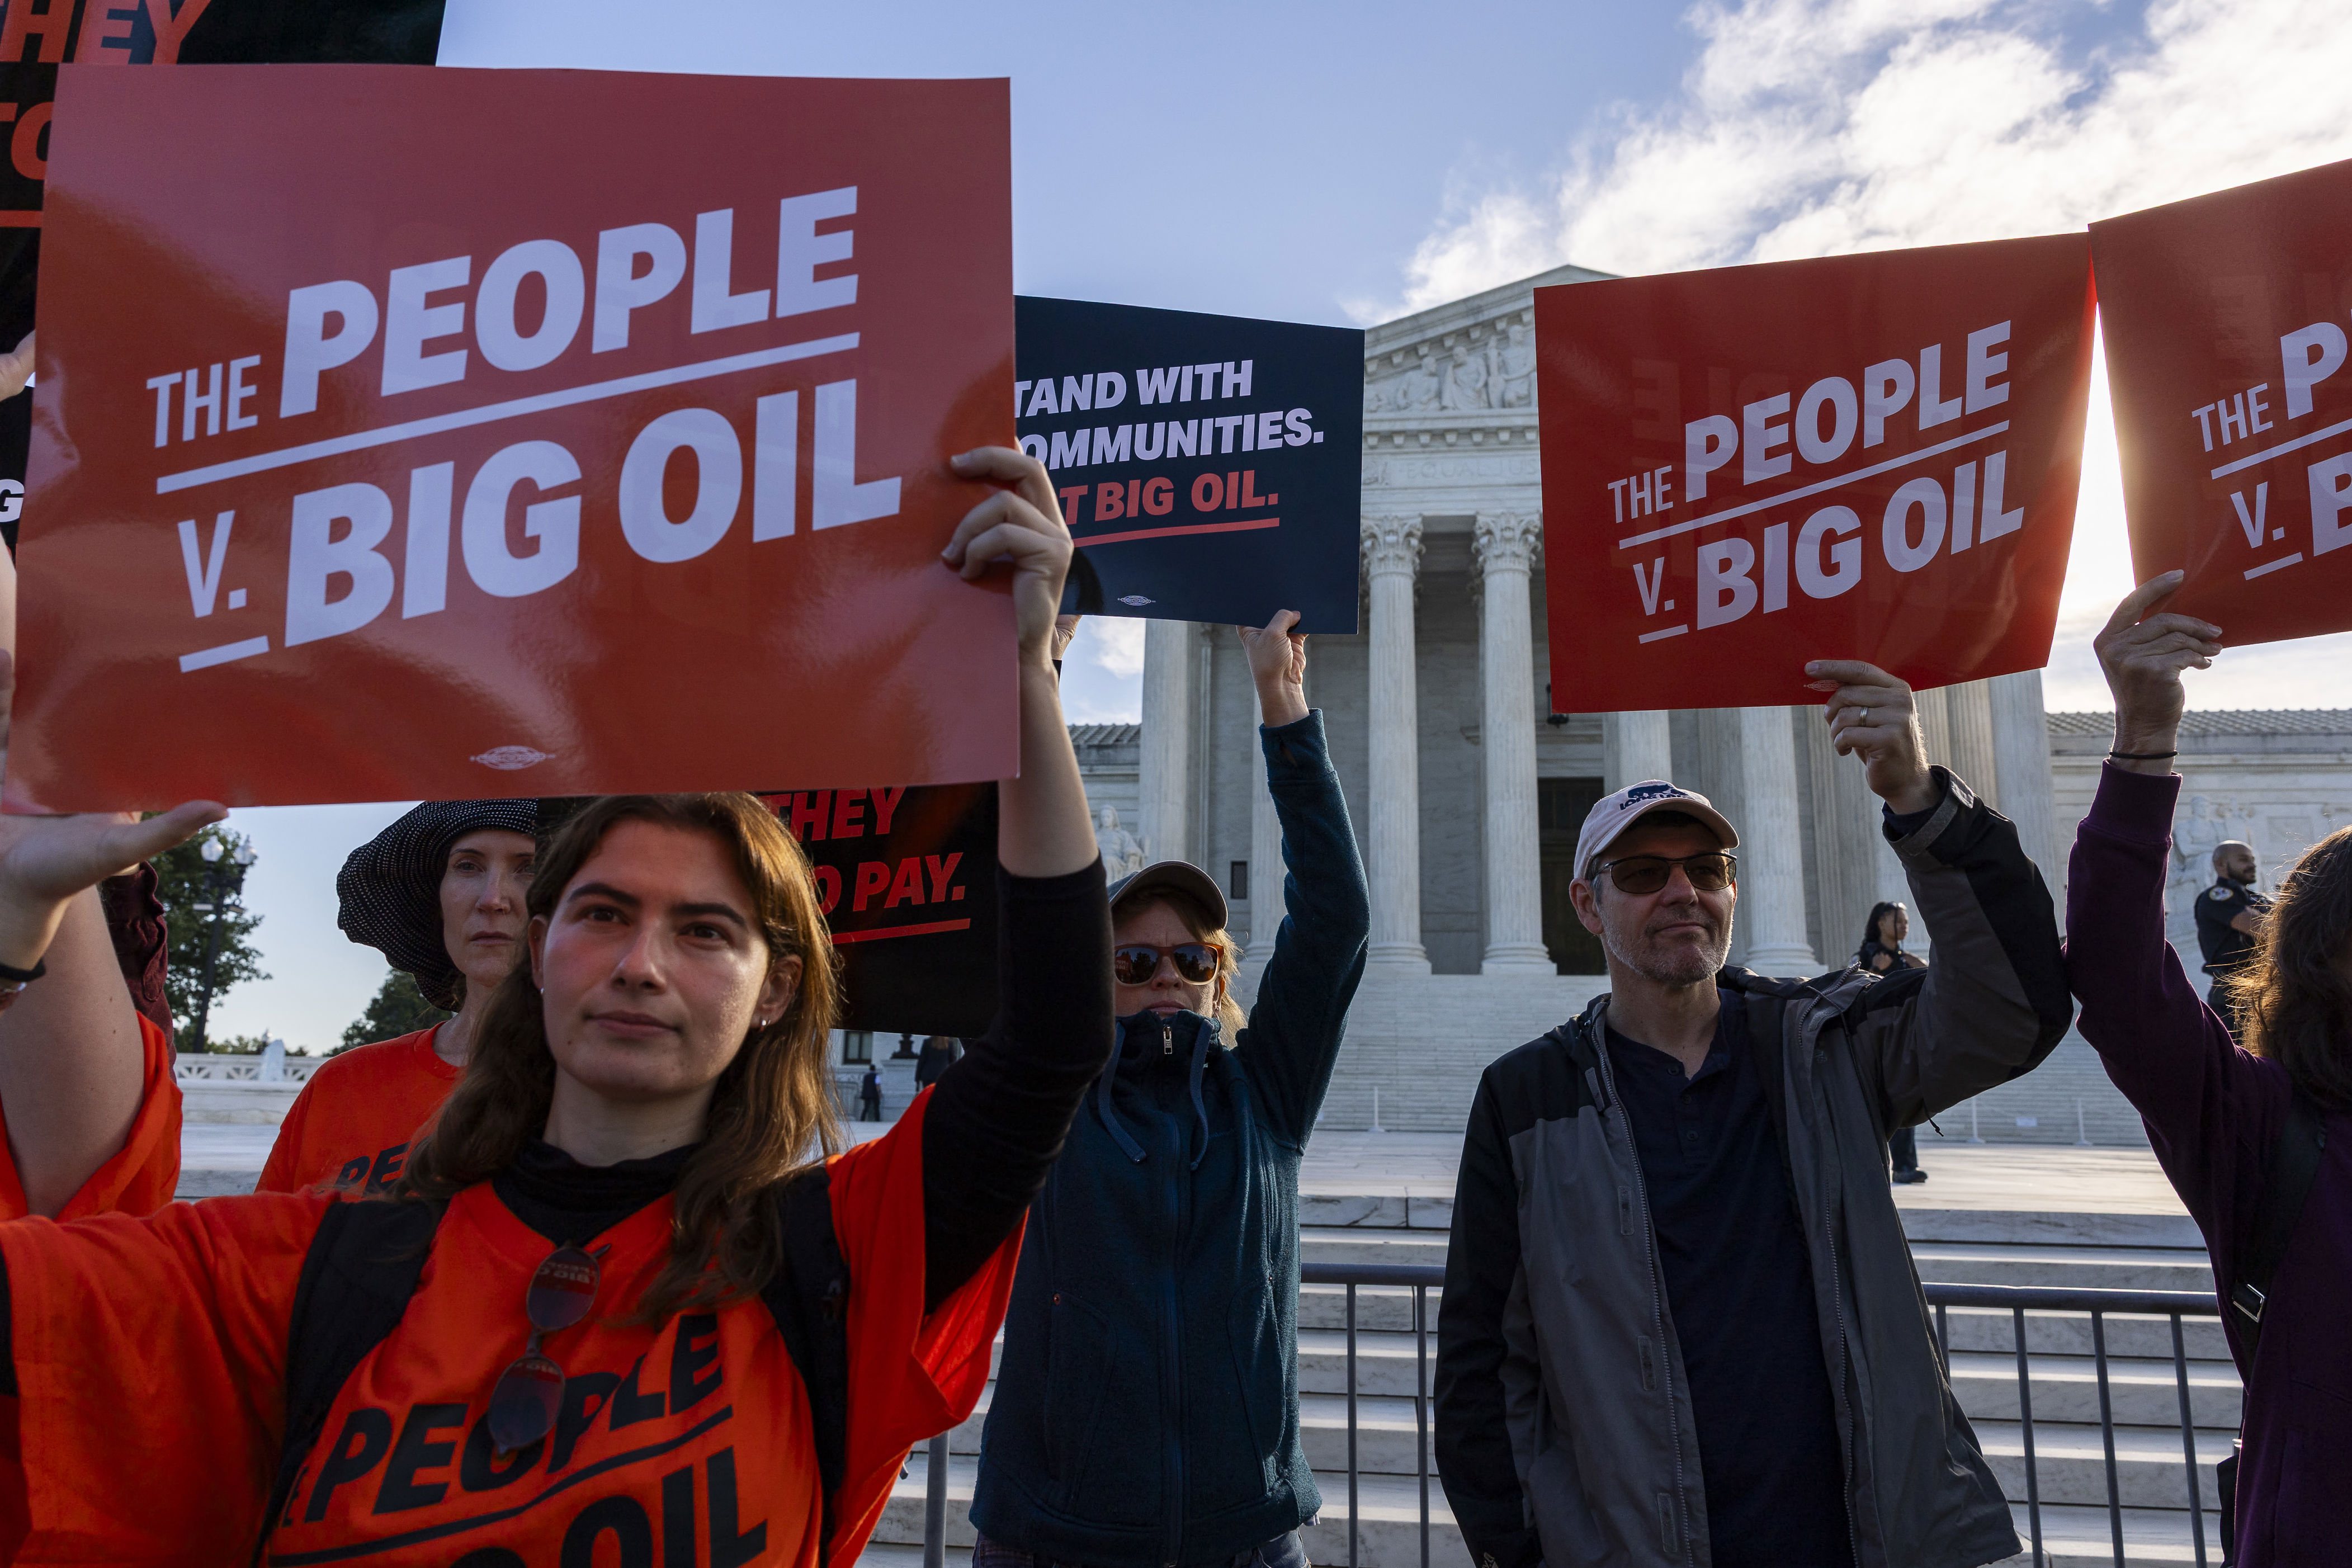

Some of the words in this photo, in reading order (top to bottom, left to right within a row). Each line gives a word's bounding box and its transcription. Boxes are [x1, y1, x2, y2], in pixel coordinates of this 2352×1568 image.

[0, 0, 211, 64] HEY
[147, 354, 261, 448] THE
[280, 185, 859, 419] PEOPLE
[1136, 360, 1253, 405] WITH
[2192, 382, 2274, 453] THE
[2280, 309, 2352, 421] P
[1607, 465, 1674, 523] THE
[1685, 320, 2011, 503] PEOPLE
[178, 509, 247, 618] V.
[285, 440, 583, 647] BIG
[618, 378, 902, 564] OIL
[1094, 476, 1174, 522] BIG
[1191, 470, 1279, 512] OIL.
[2230, 481, 2285, 549] V.
[1633, 556, 1675, 616] V.
[1697, 506, 1862, 631] BIG
[1882, 450, 2025, 573] OIL
[757, 787, 906, 842] THEY
[853, 852, 966, 911] PAY.
